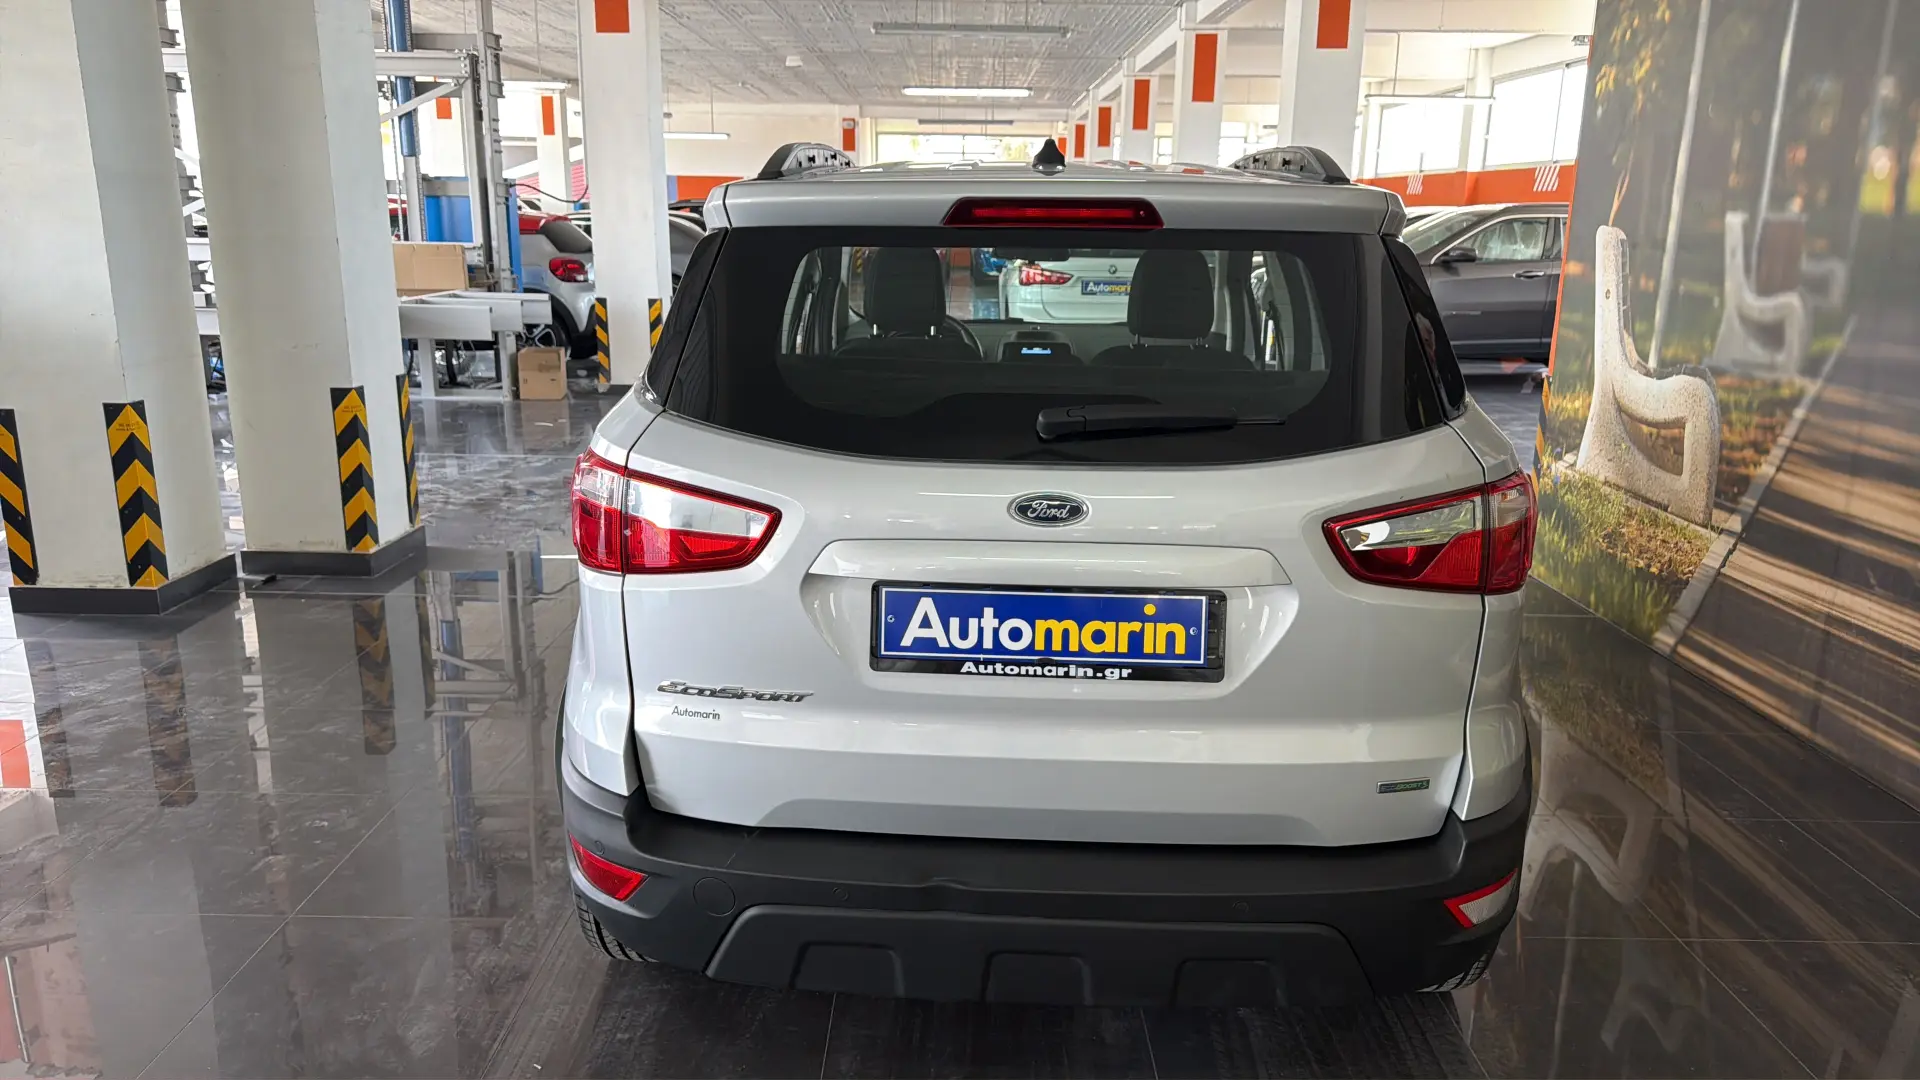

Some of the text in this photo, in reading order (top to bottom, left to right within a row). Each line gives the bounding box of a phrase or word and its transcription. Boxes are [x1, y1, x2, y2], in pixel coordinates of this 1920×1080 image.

[1086, 281, 1131, 292] Automari
[1027, 499, 1070, 518] Ford
[900, 597, 1186, 655] Automarin
[960, 661, 1133, 680] Automarin.gr
[671, 705, 720, 720] Automarin
